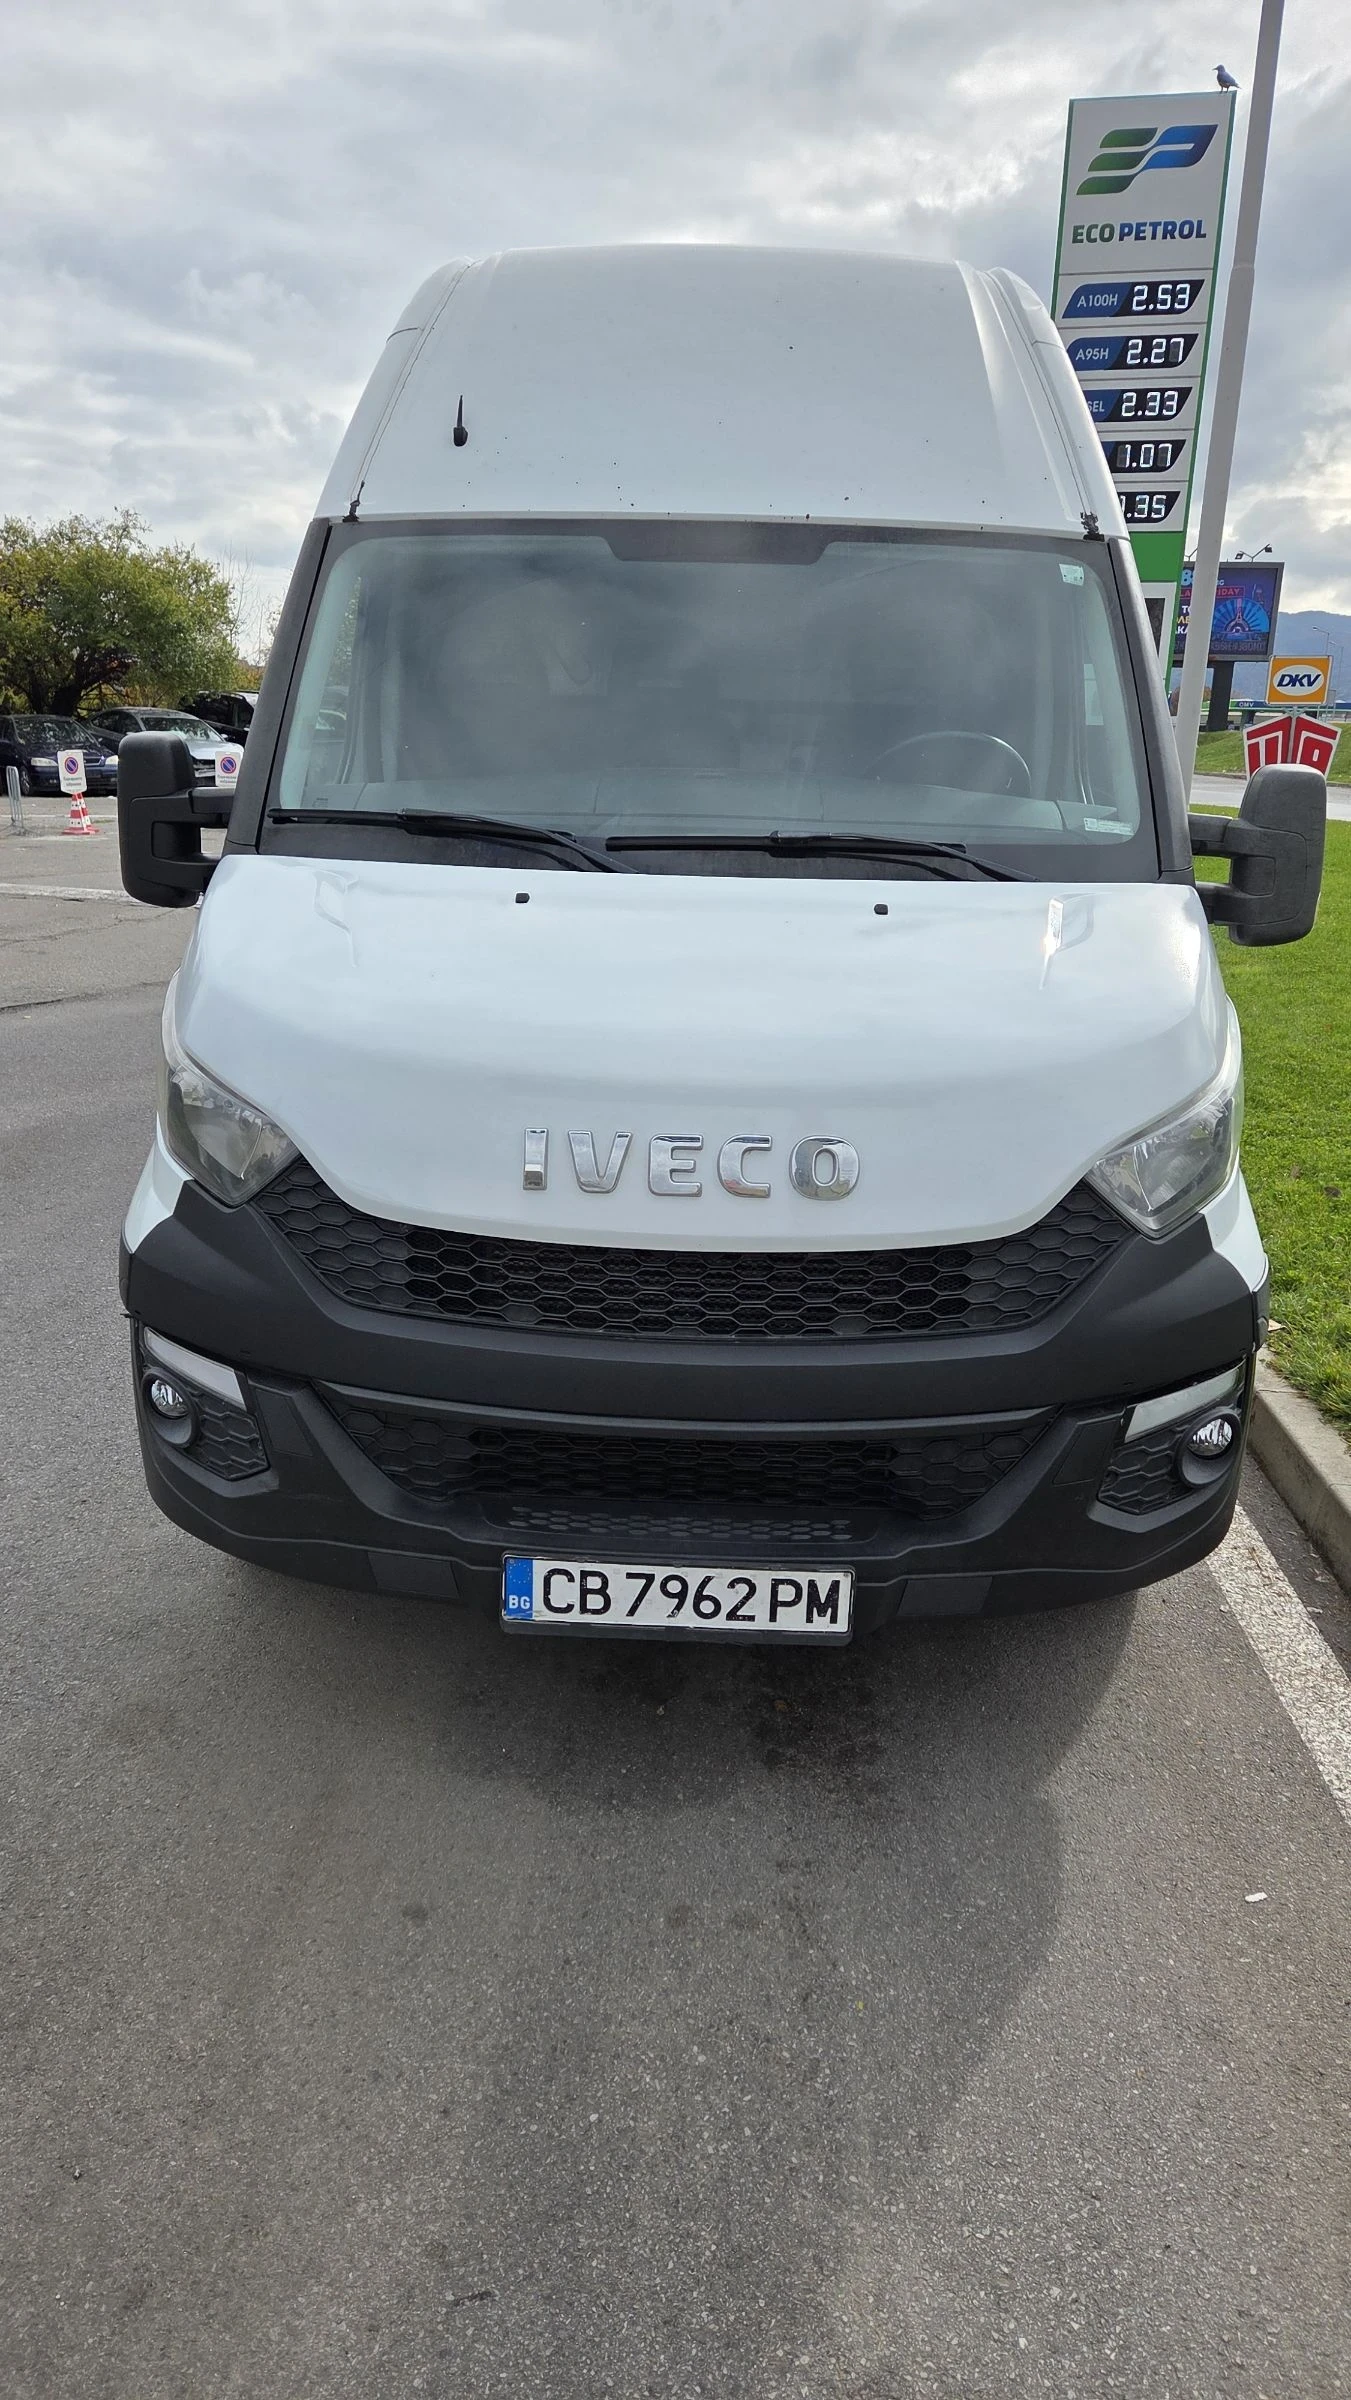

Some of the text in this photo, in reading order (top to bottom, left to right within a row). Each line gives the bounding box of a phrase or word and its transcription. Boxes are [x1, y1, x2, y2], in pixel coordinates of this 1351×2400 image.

[1077, 283, 1191, 312] A100H 2.53
[1075, 337, 1185, 365] A95H 2.27
[1086, 390, 1179, 417] SEL 2.33
[1124, 443, 1173, 469] 1.07
[1276, 673, 1322, 689] DKV
[522, 1128, 861, 1201] IVECO
[508, 1594, 531, 1610] BG
